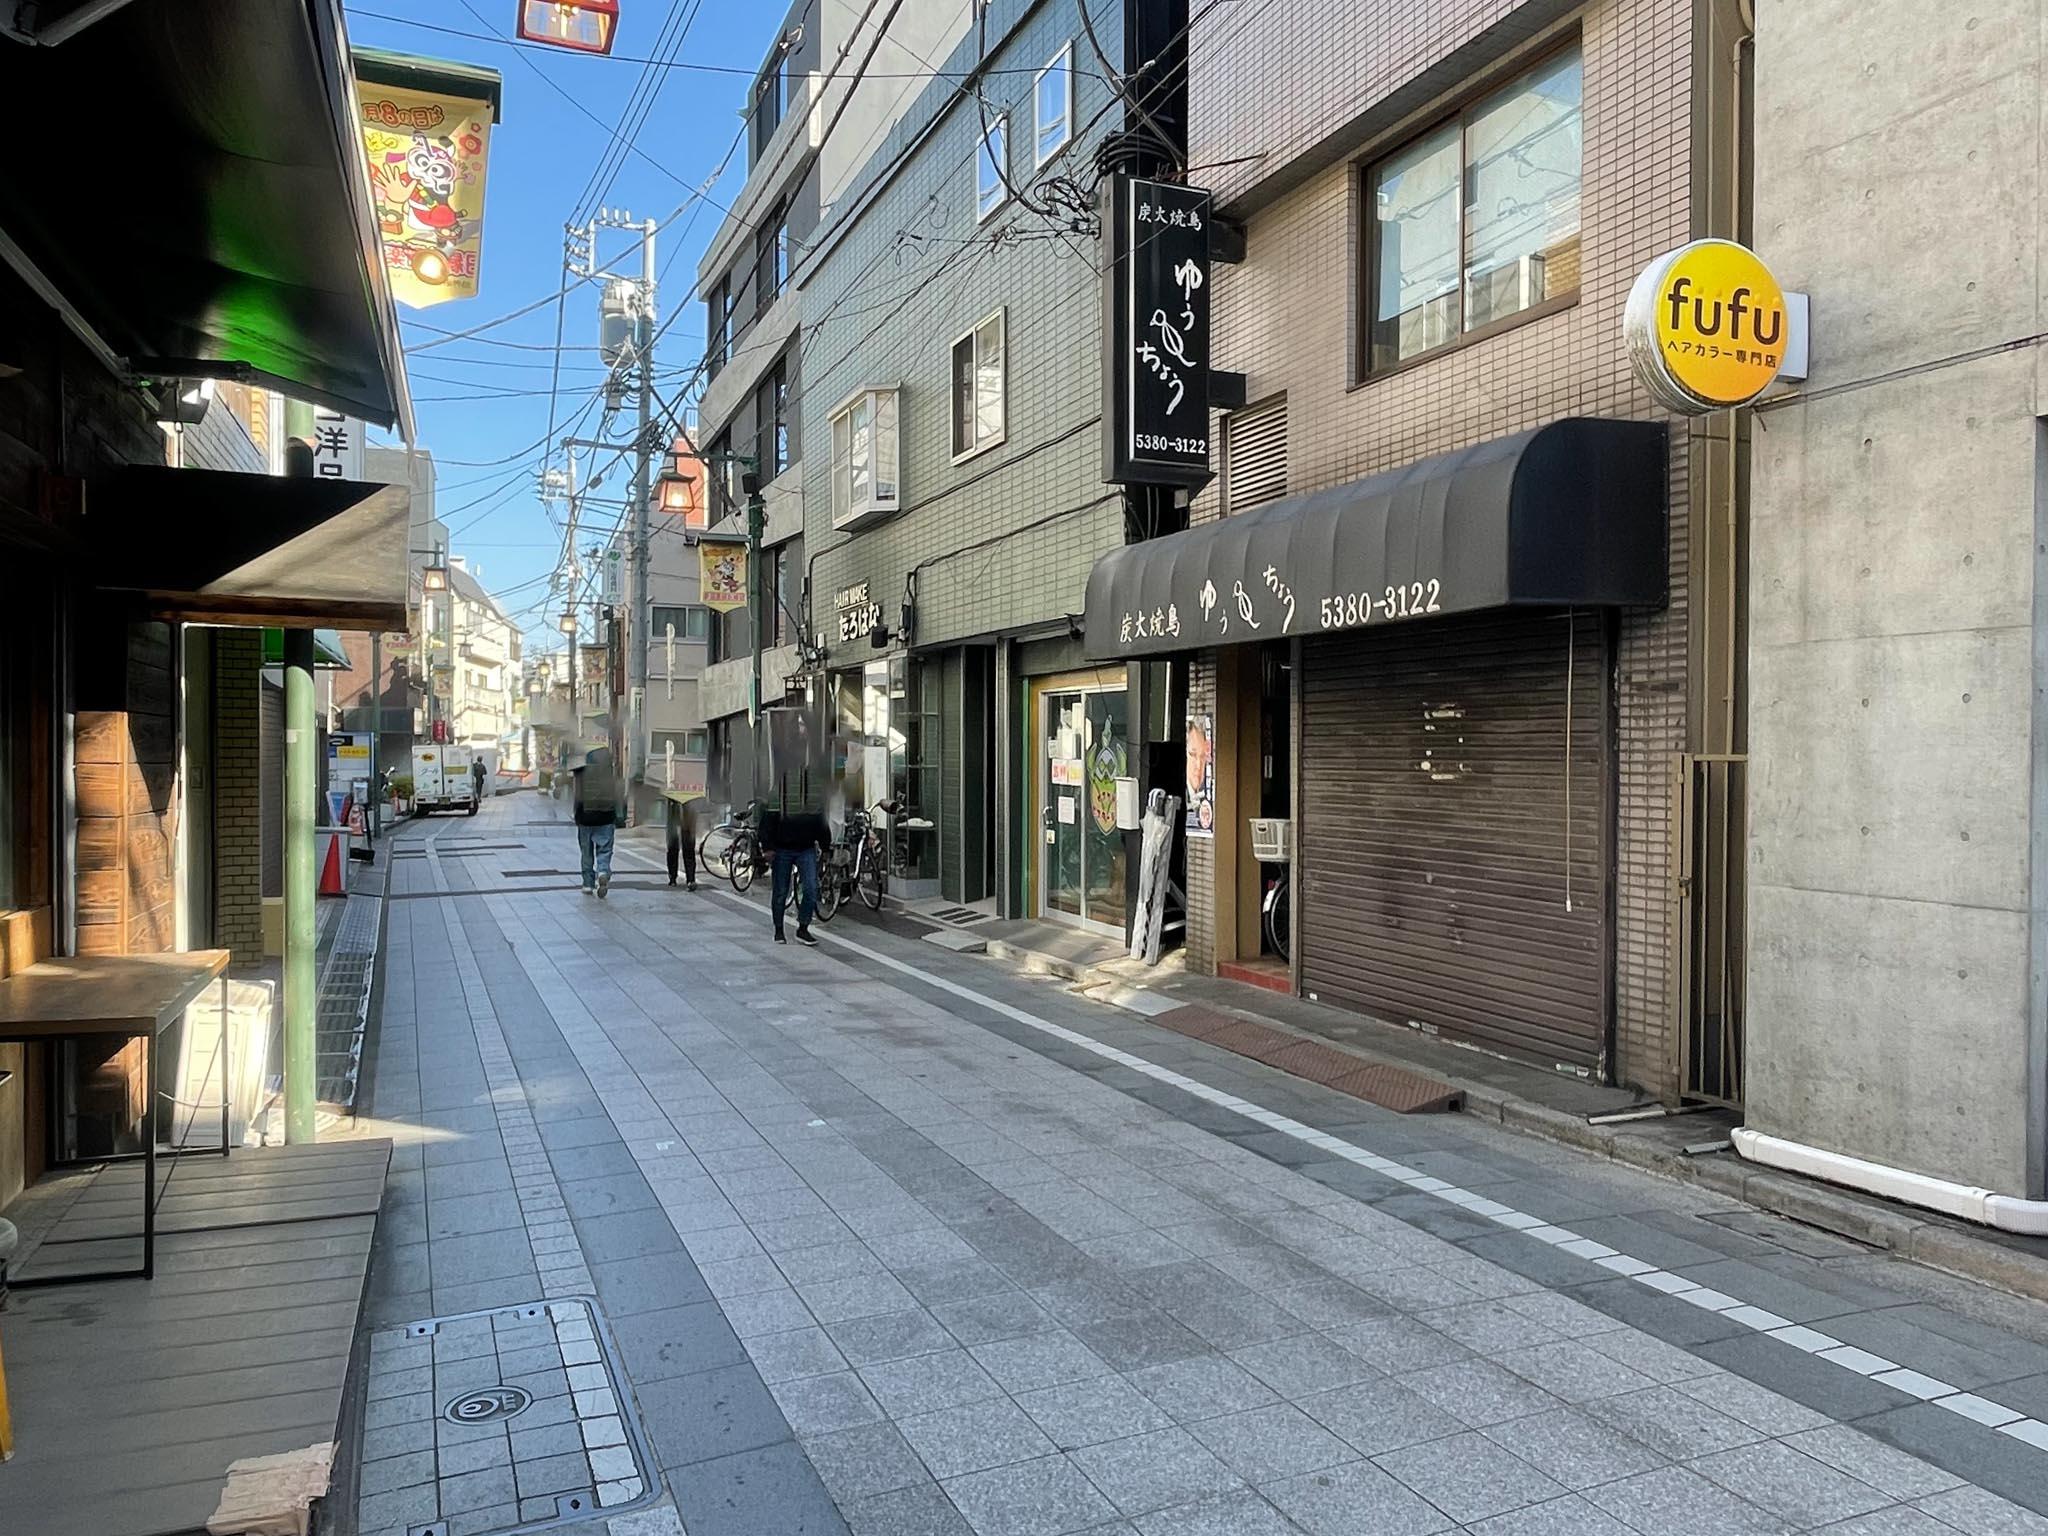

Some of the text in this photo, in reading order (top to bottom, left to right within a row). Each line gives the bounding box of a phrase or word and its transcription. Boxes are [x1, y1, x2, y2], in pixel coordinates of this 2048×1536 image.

[1138, 203, 1202, 231] 炭火焼鳥
[1667, 277, 1781, 345] fufu
[1667, 340, 1777, 369] ヘアカラー専門店
[1136, 434, 1206, 455] 5380-3122
[1321, 578, 1441, 629] 5380-3122
[839, 602, 880, 643] たろはな
